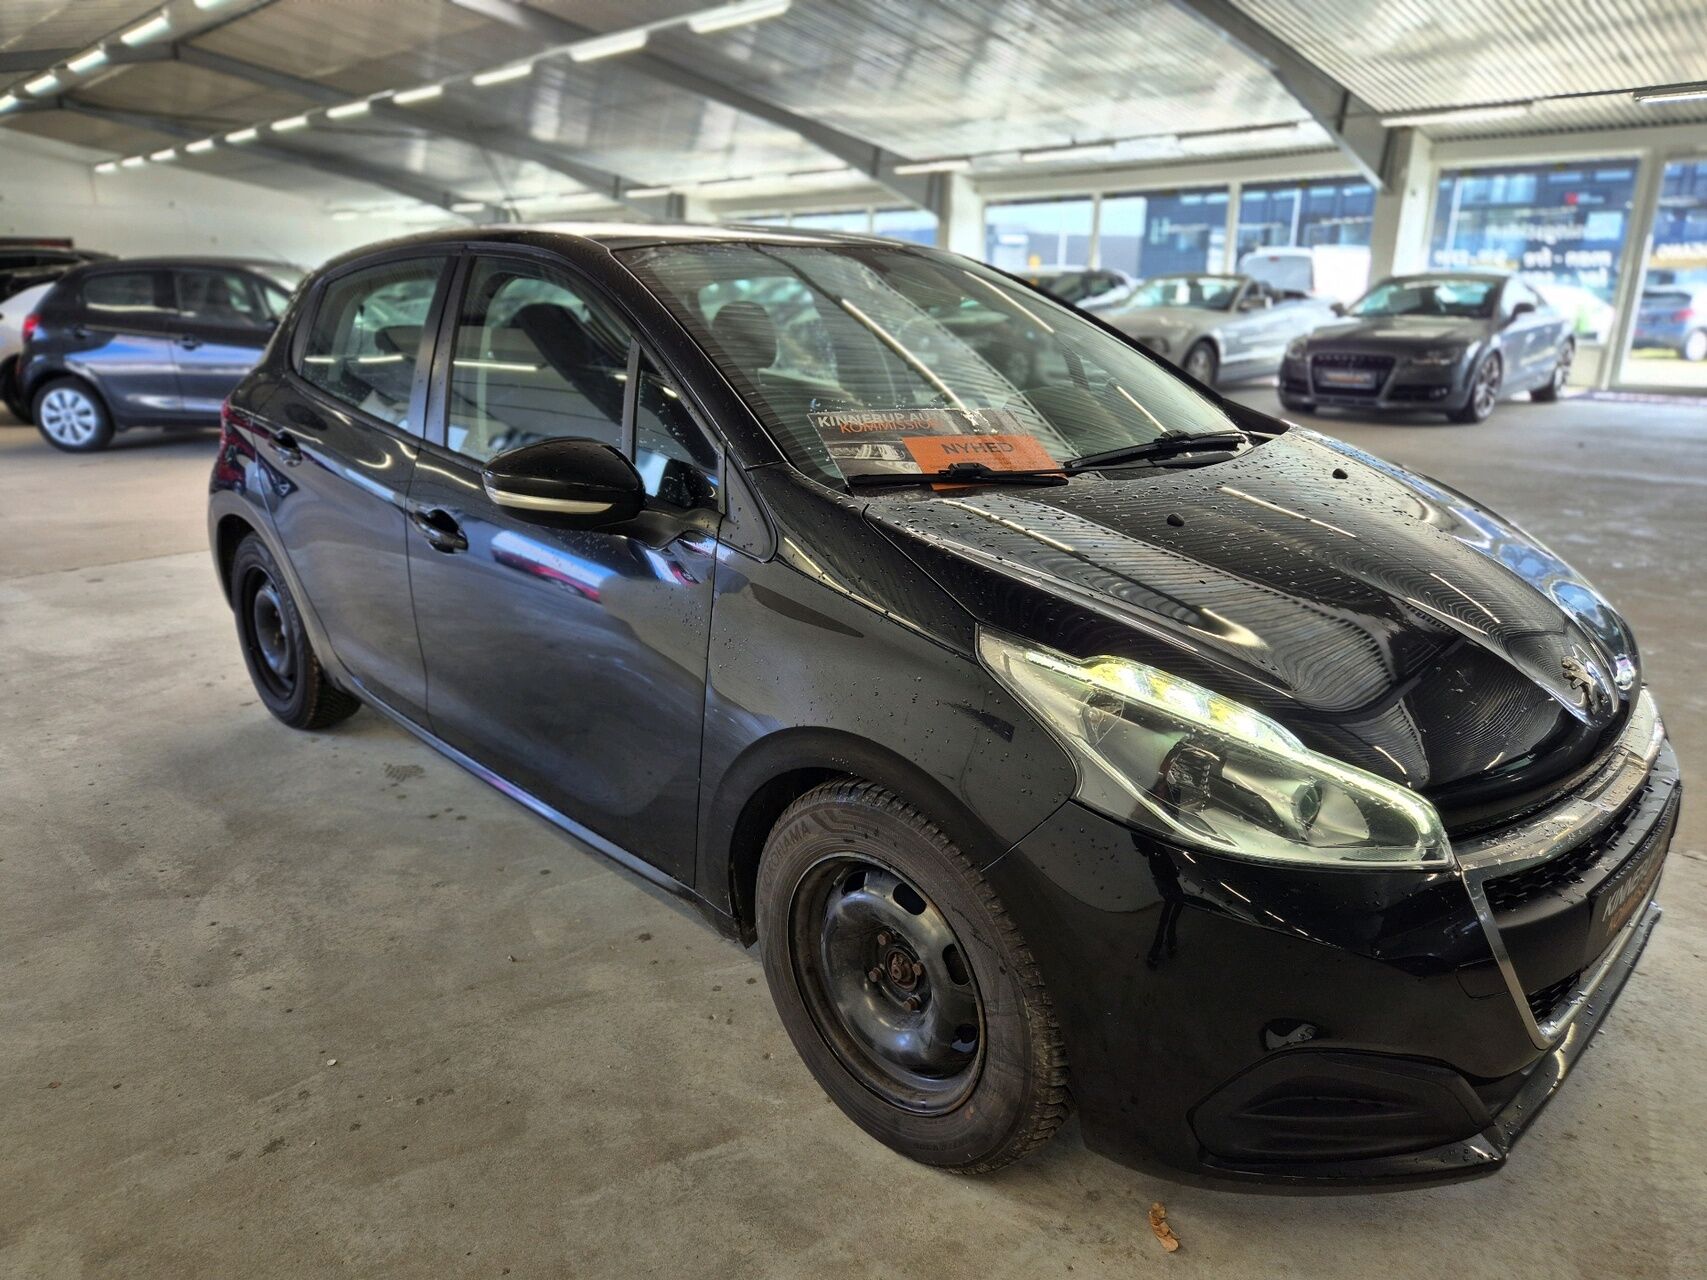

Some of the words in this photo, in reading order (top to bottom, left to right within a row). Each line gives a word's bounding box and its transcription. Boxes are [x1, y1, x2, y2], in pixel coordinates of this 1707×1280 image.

[817, 412, 905, 427] KINNERUP
[840, 418, 944, 433] KOMMISSIO
[941, 442, 1015, 454] NYHED
